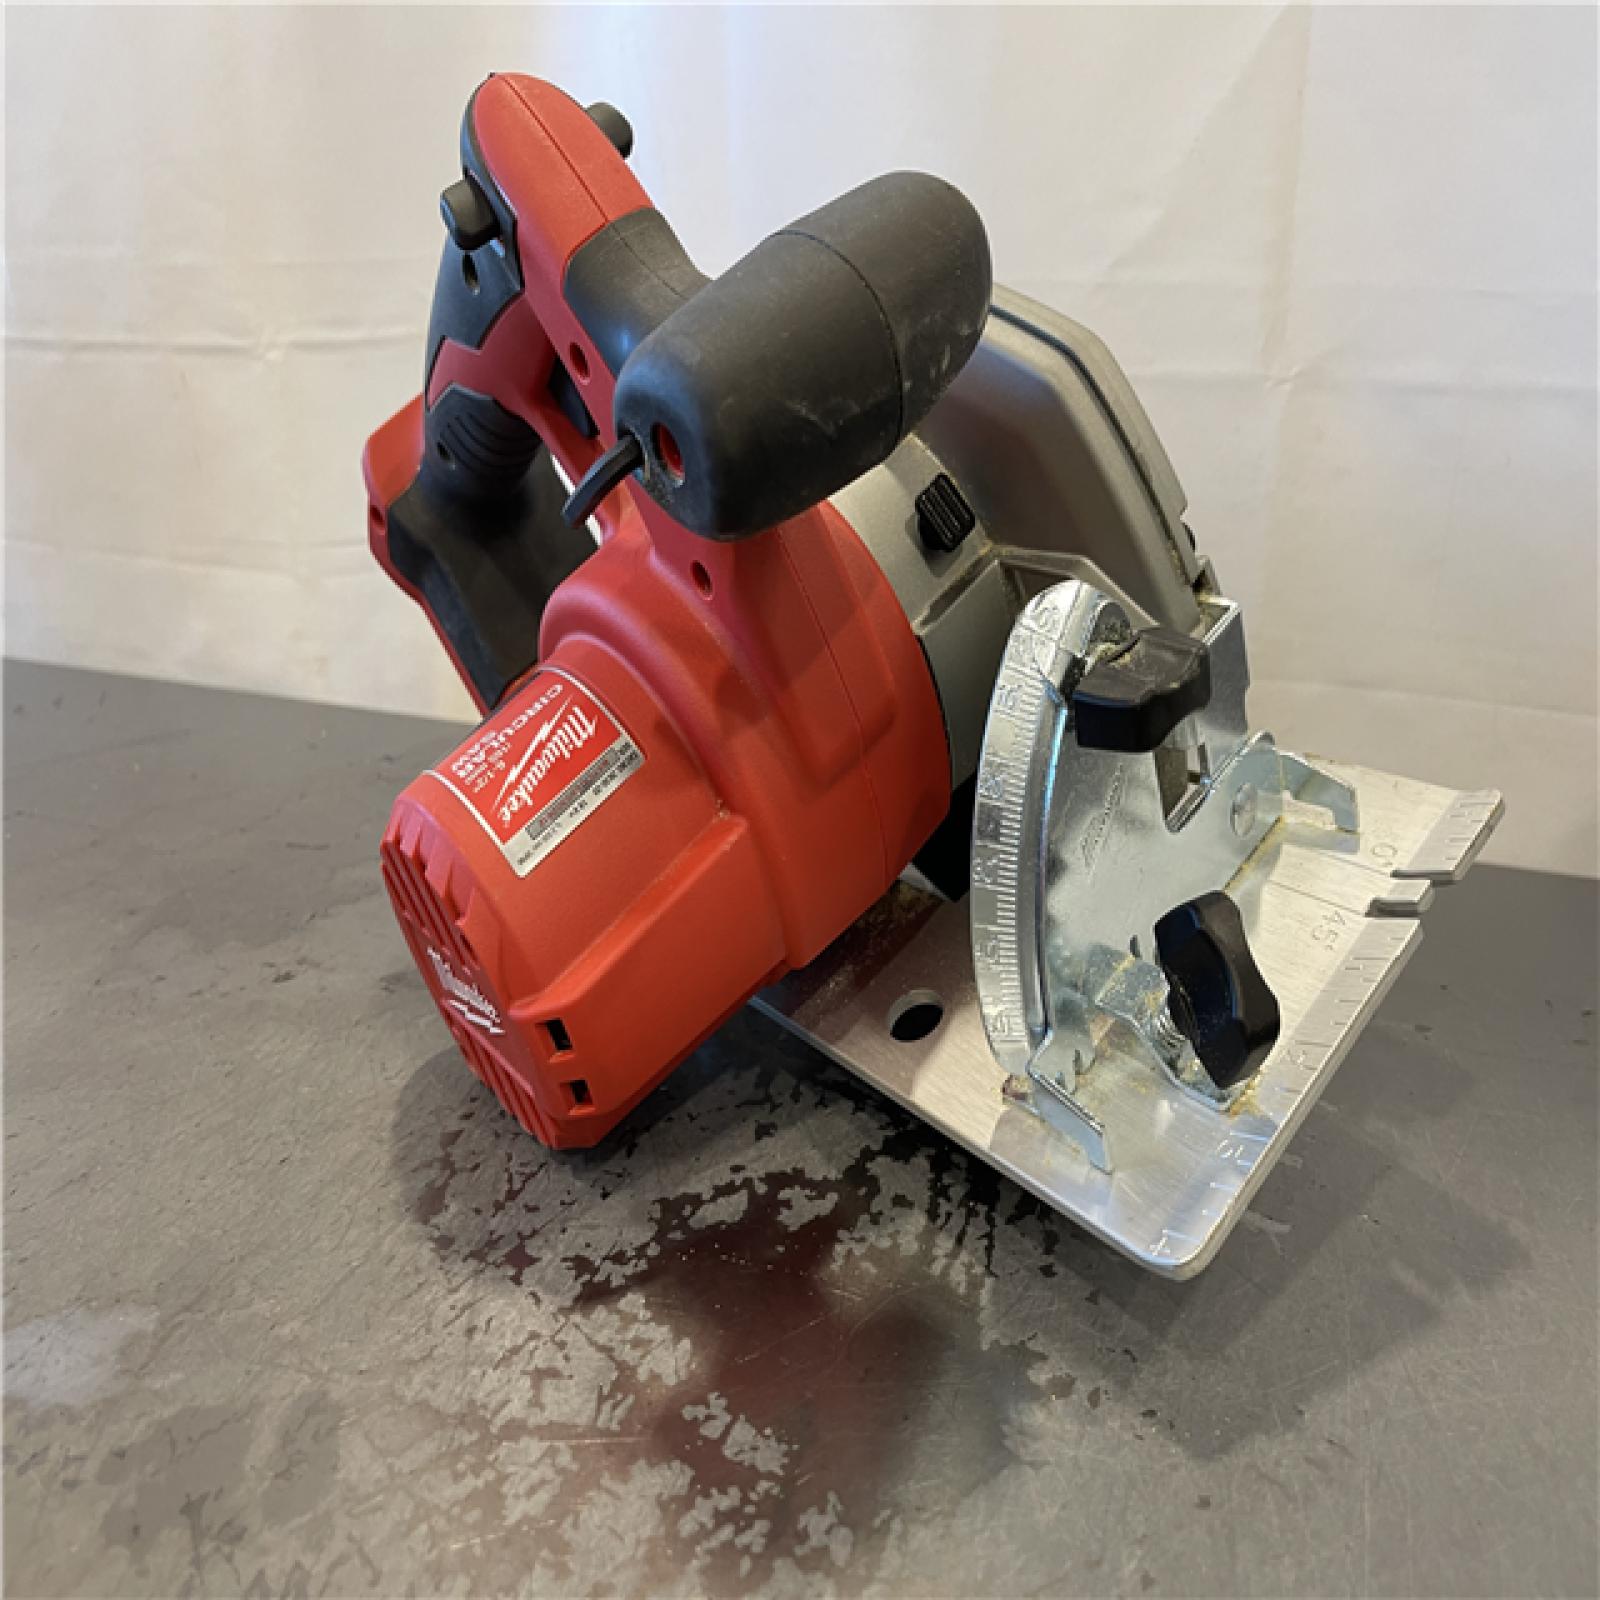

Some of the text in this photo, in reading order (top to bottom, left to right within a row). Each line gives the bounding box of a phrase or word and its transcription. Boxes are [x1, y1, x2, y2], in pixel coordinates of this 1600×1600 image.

[448, 730, 498, 774] SAW
[451, 684, 563, 780] CIRCULAR
[499, 706, 598, 829] Milwaukee
